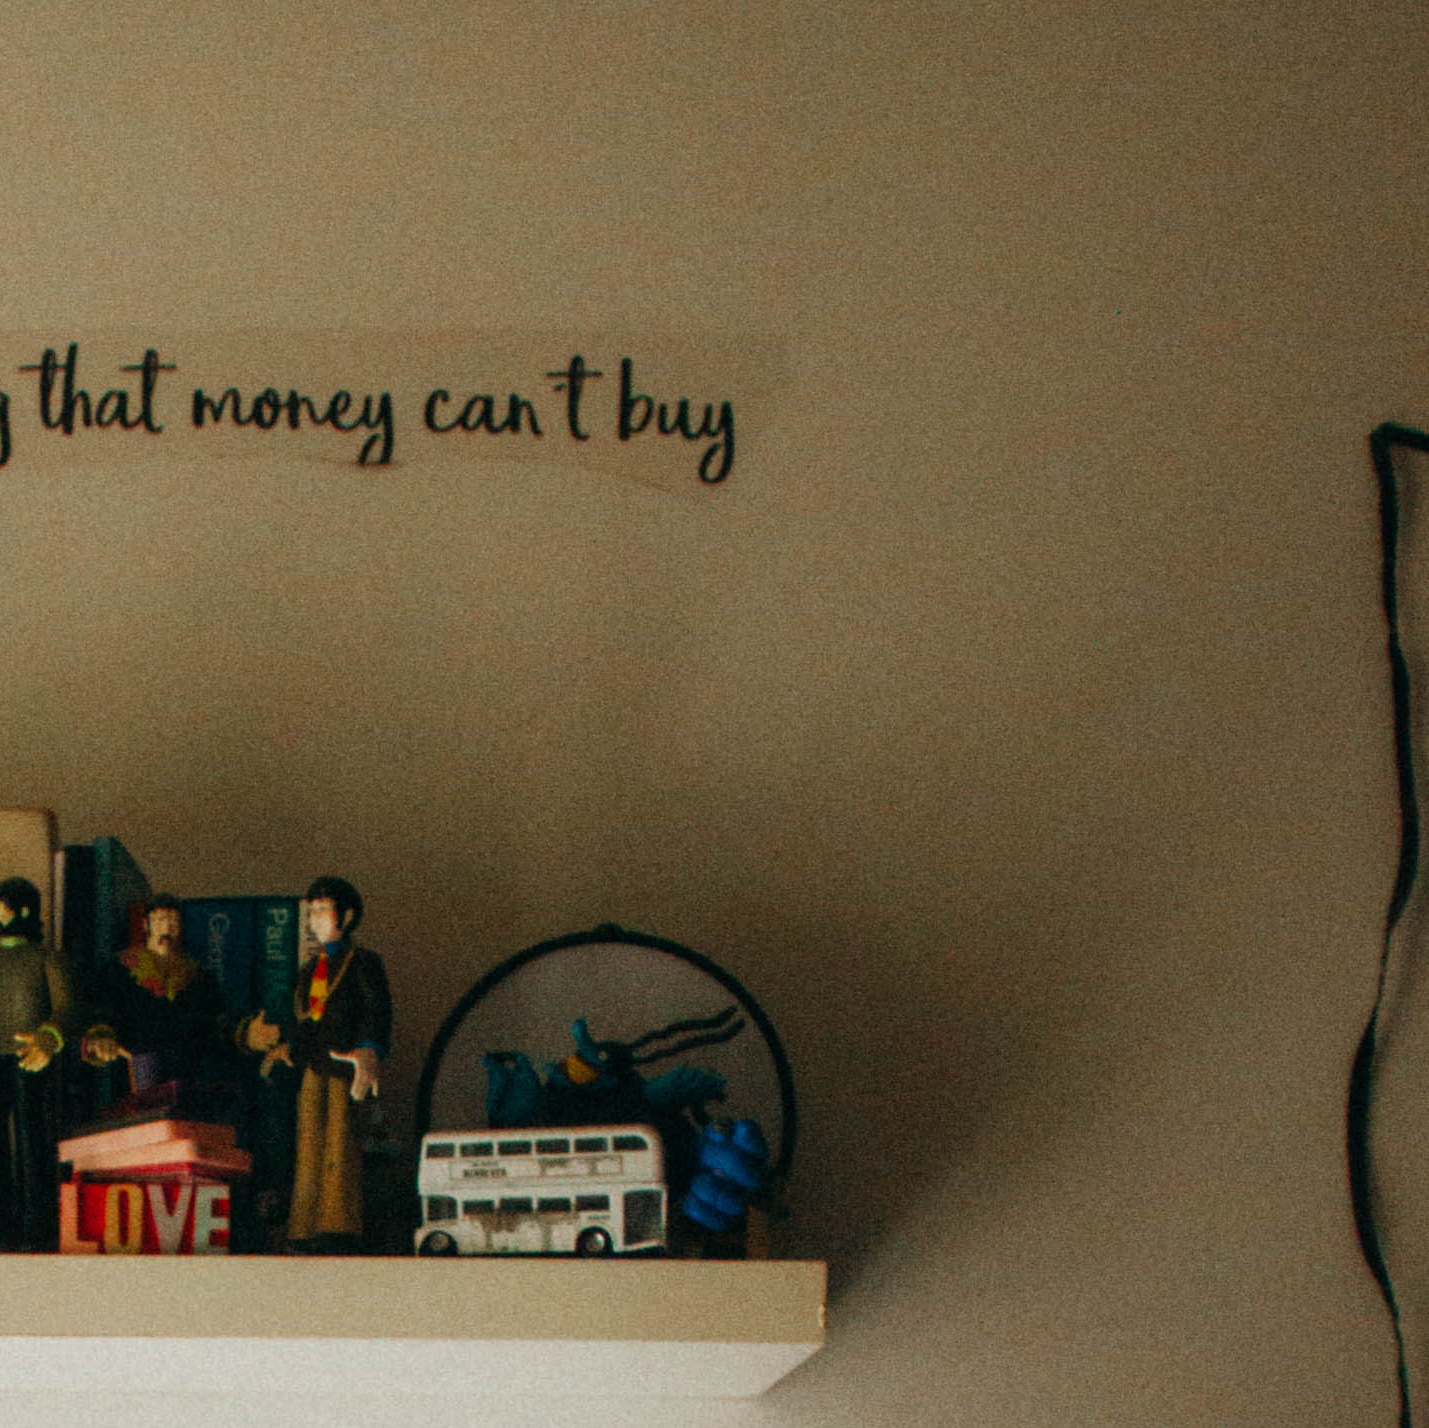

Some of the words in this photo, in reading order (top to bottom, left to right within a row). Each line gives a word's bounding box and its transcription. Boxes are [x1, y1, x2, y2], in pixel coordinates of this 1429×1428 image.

[19, 343, 177, 437] that
[190, 386, 396, 470] money
[421, 354, 606, 444] can't
[615, 355, 738, 488] buy
[266, 907, 290, 962] Paul
[60, 1182, 230, 1255] LOVE
